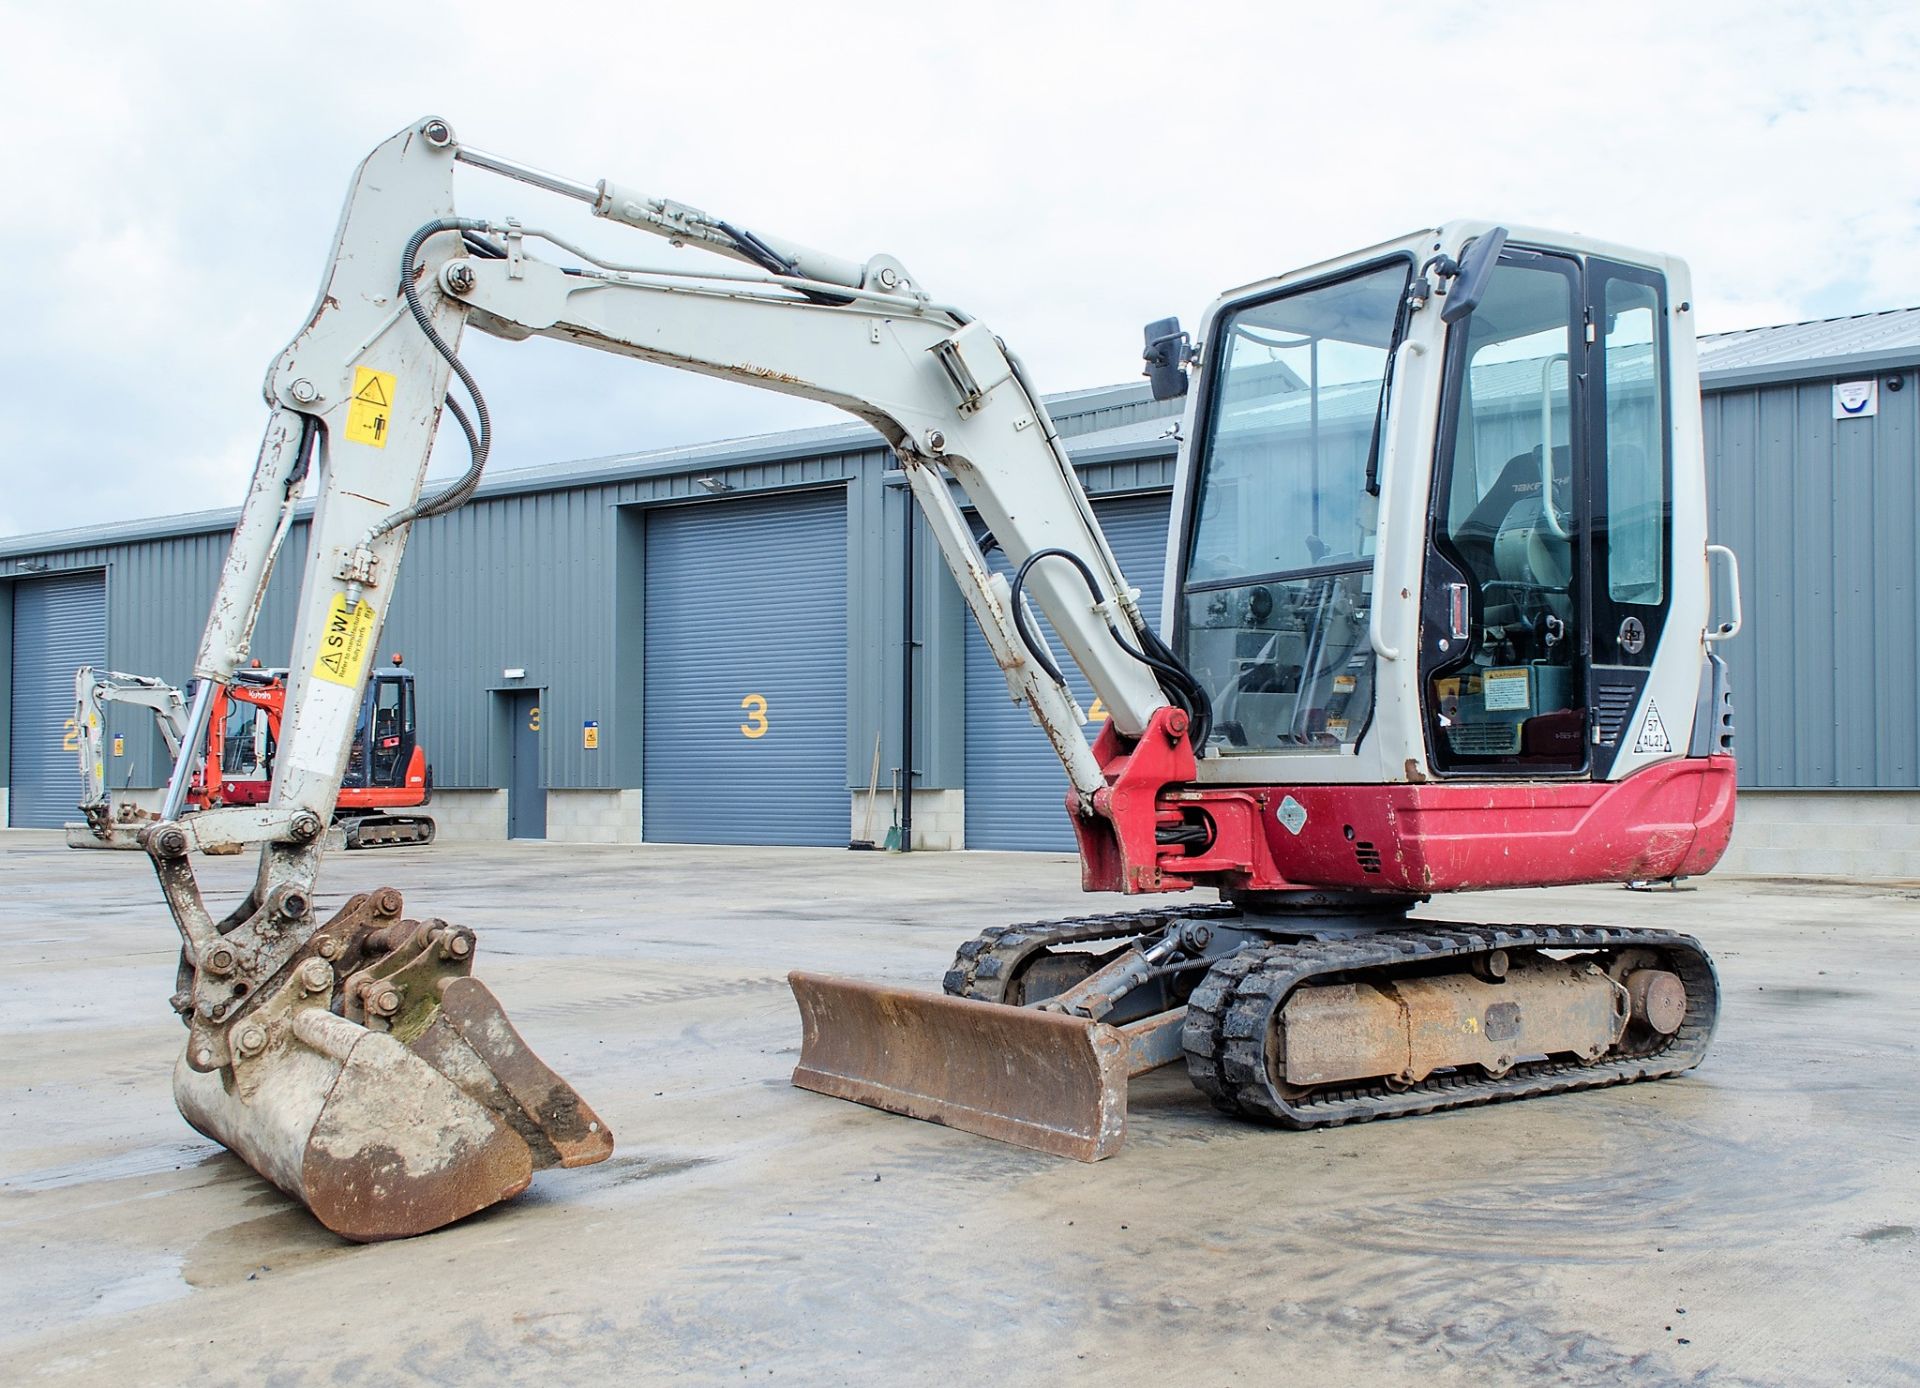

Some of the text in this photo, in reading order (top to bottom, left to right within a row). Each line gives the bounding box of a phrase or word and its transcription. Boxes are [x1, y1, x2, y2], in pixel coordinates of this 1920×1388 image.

[352, 627, 366, 662] duty charts
[338, 660, 348, 678] Refer
[529, 707, 540, 731] 3
[741, 694, 769, 738] 3
[1648, 719, 1658, 731] 57
[63, 719, 80, 751] 2
